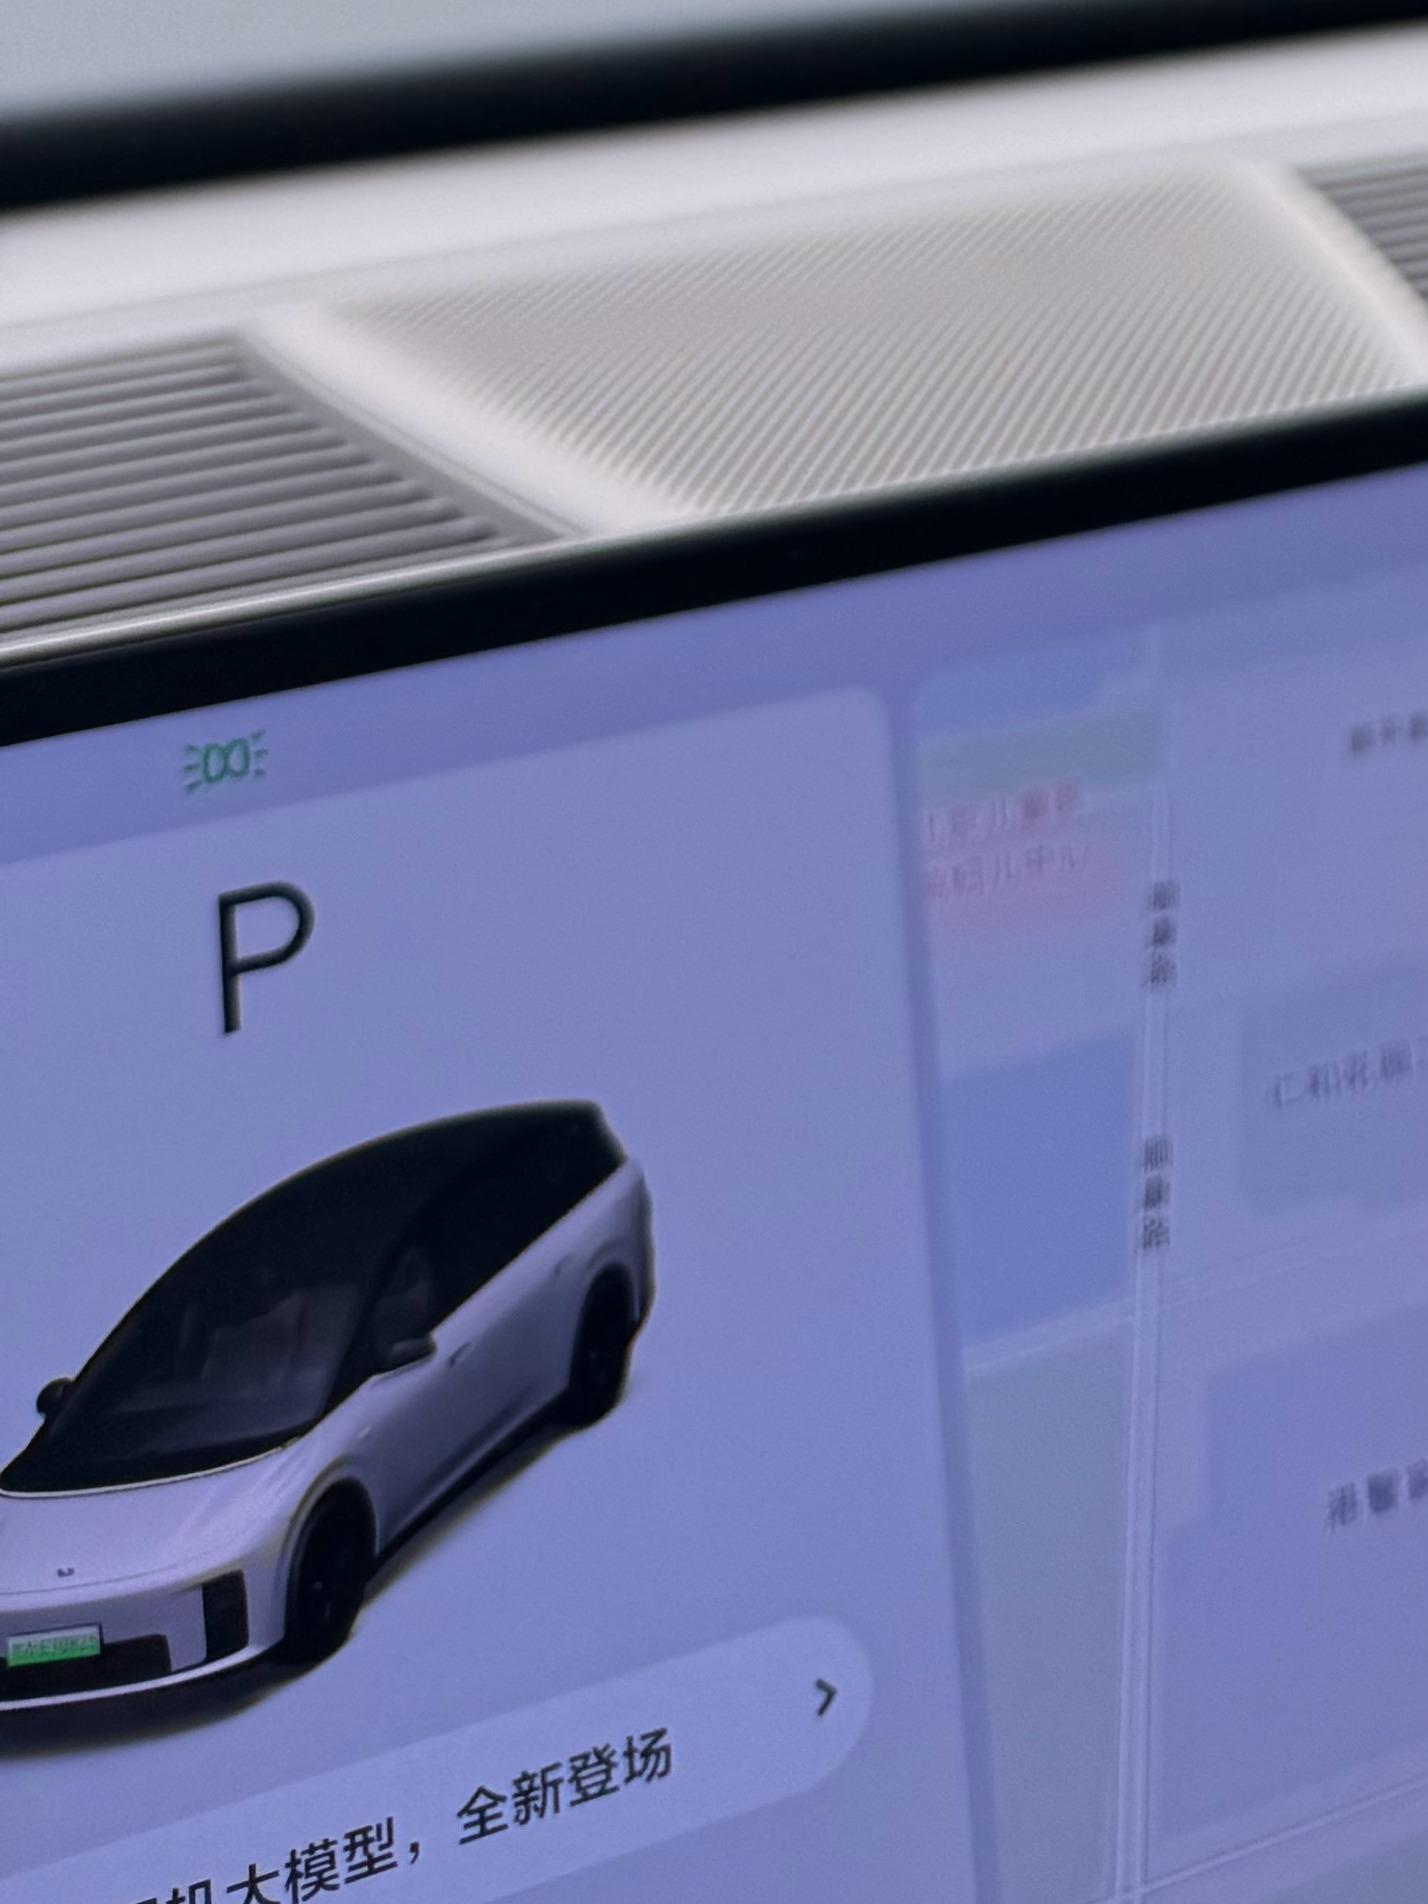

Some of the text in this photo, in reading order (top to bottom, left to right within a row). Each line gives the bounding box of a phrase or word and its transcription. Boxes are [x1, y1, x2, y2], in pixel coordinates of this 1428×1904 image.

[214, 879, 317, 1037] P
[134, 1726, 673, 1904] 大模型，全新登场
